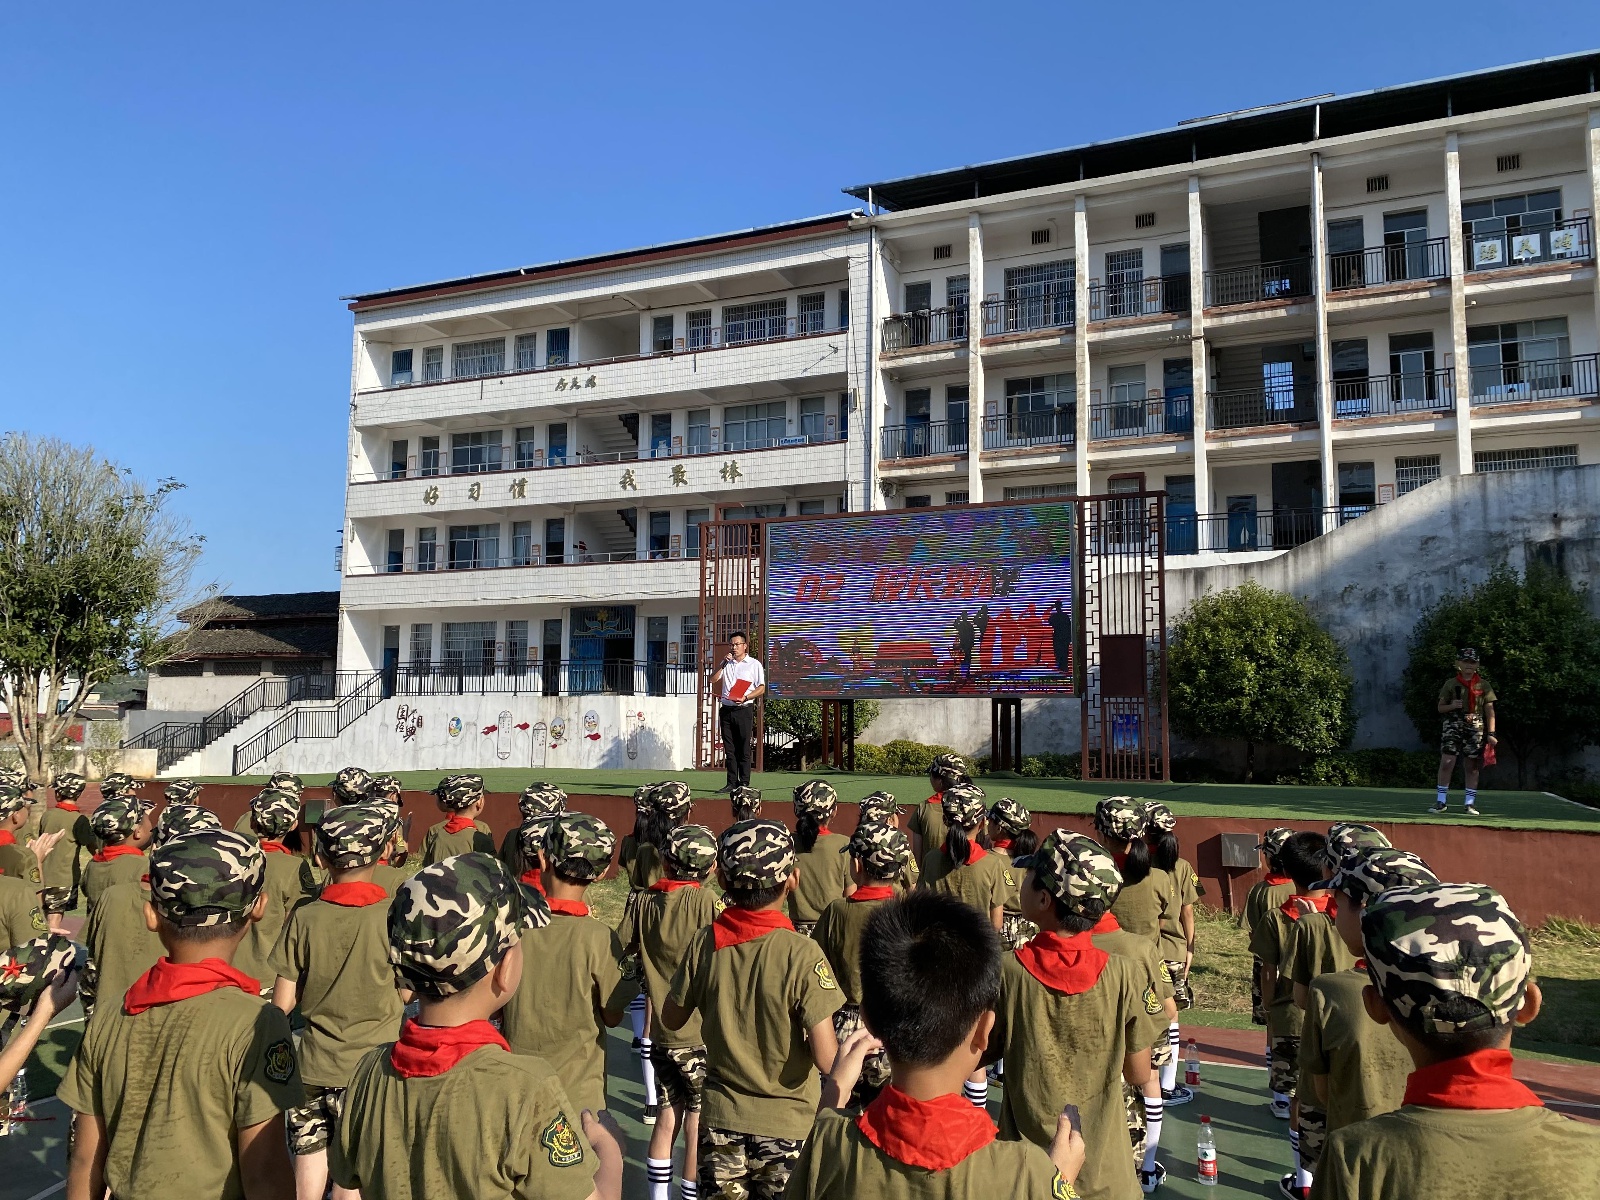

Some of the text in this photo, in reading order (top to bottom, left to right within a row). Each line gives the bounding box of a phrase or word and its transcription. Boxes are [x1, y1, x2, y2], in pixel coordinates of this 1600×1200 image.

[423, 459, 743, 505] 好习惯 我最棒
[795, 573, 846, 603] 02
